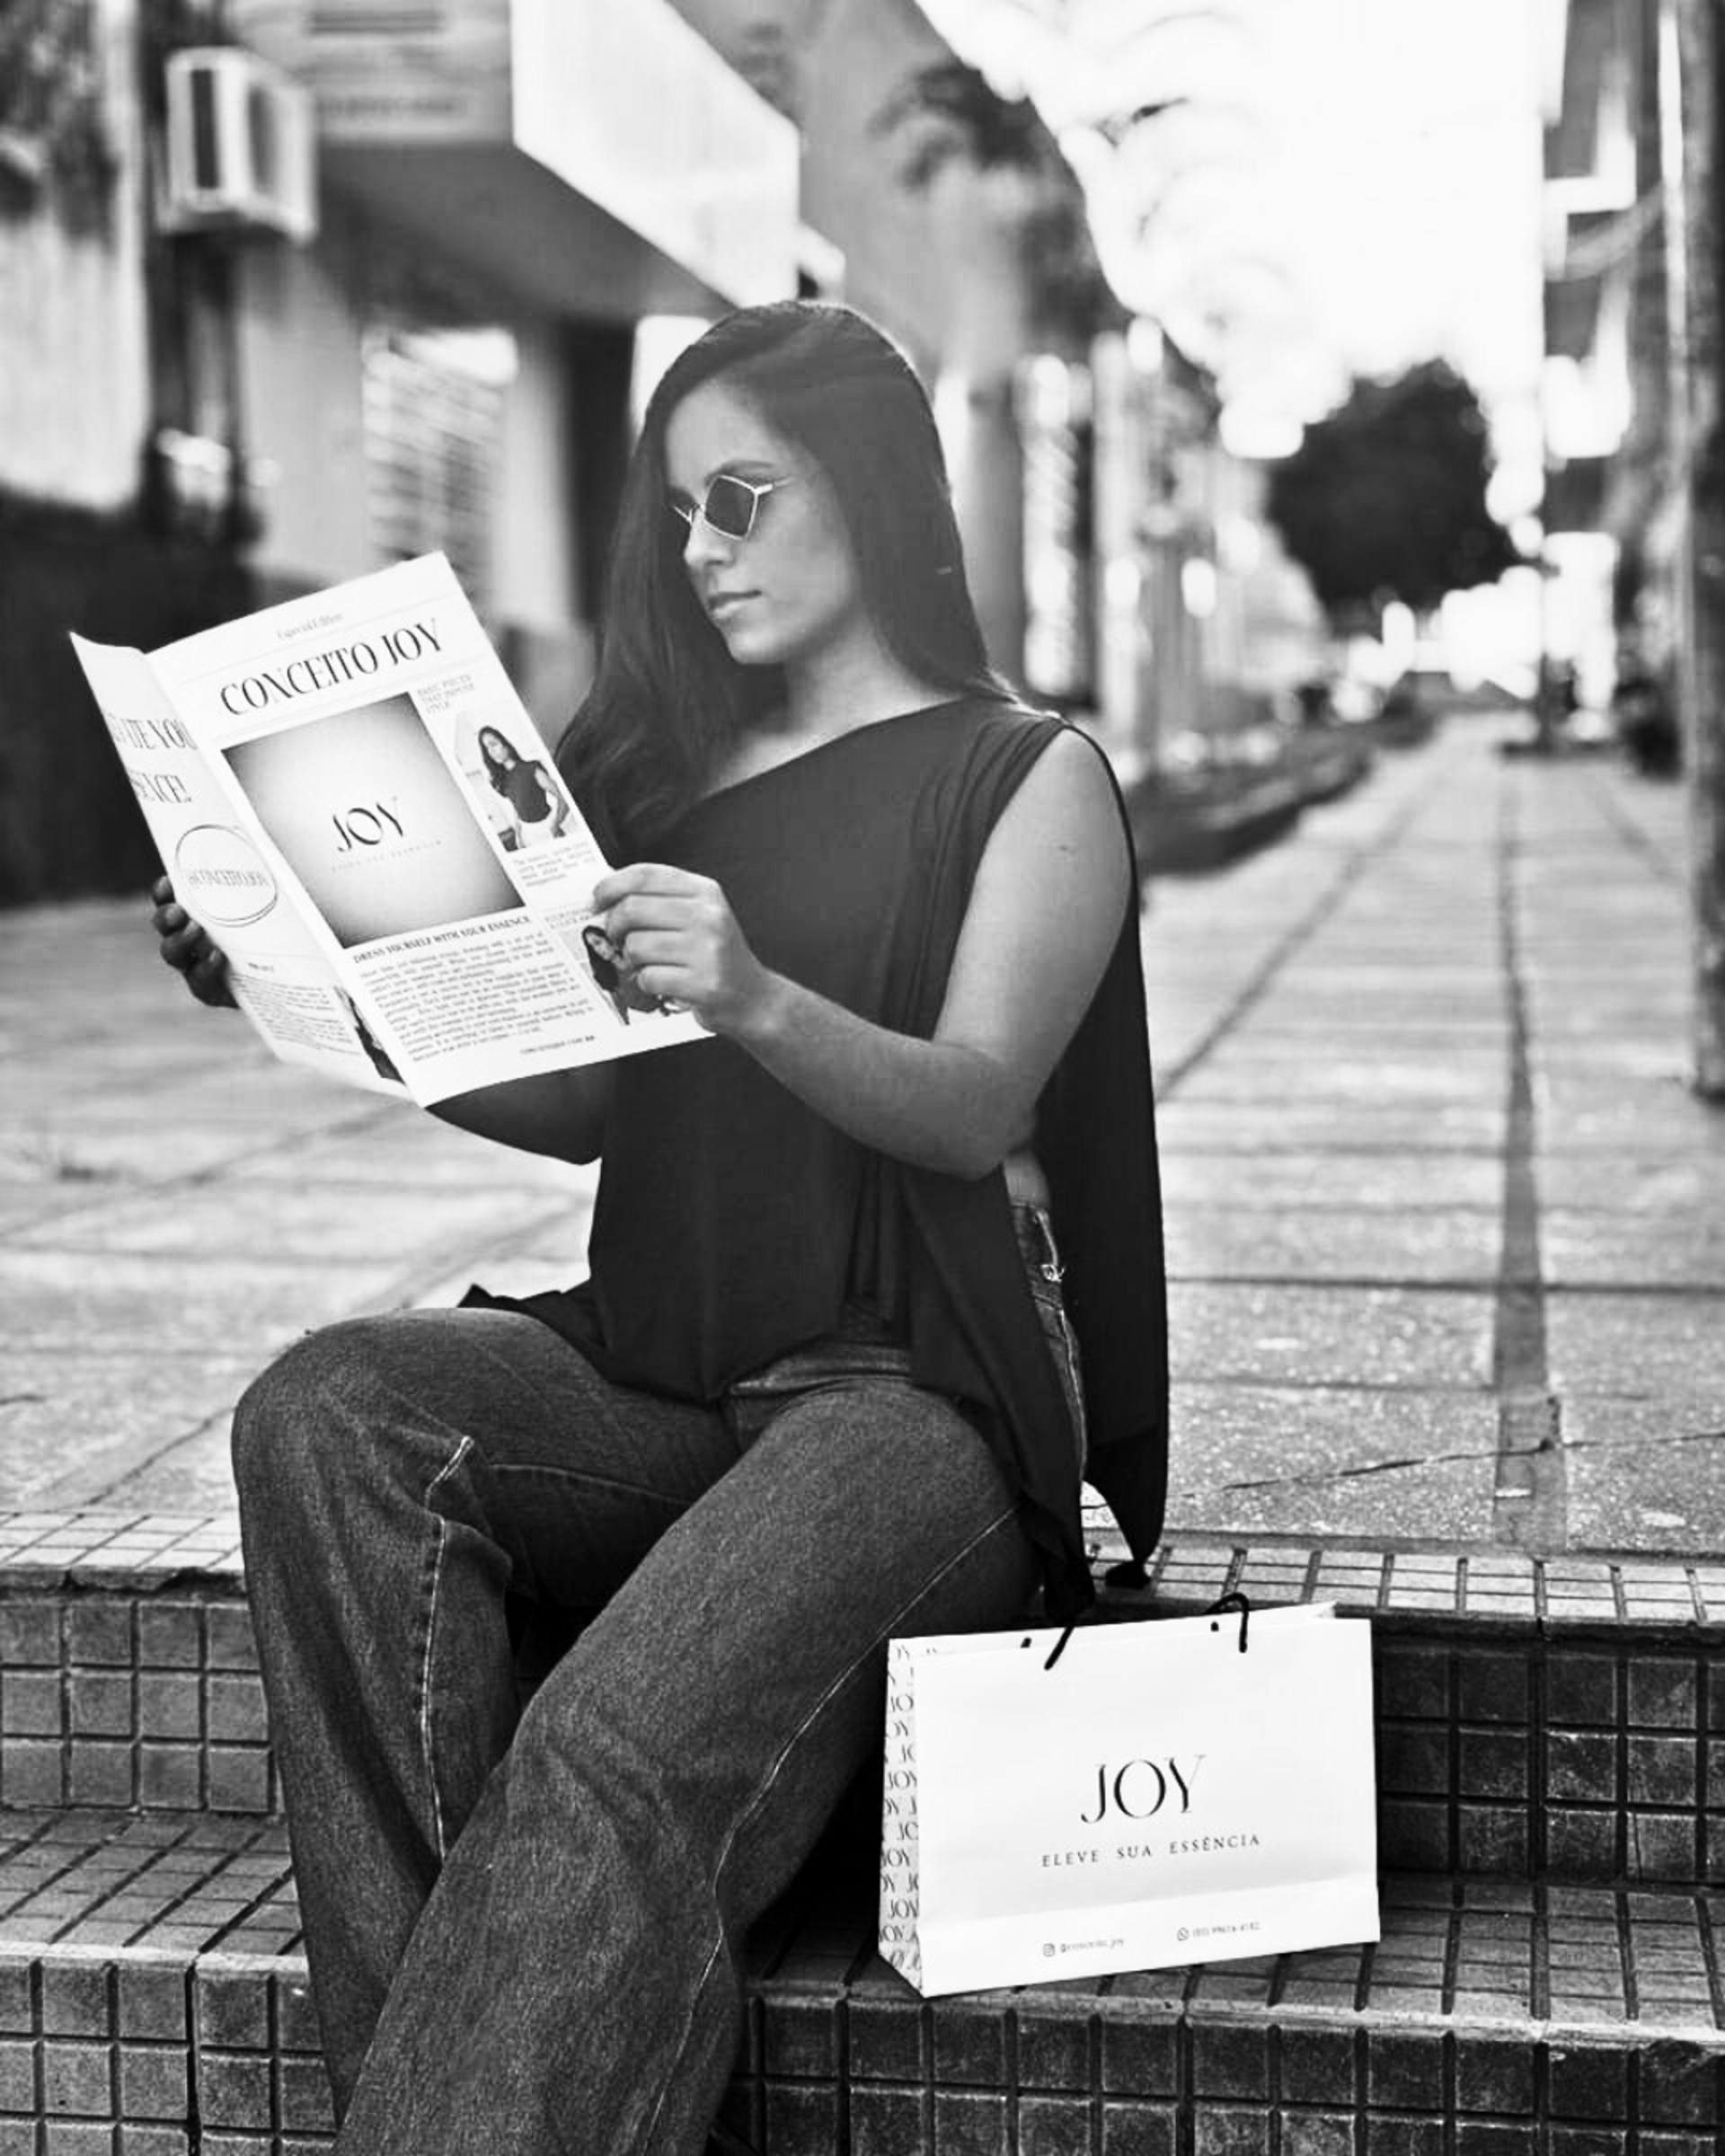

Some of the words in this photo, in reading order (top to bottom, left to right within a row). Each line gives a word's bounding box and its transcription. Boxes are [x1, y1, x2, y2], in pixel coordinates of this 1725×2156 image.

[220, 642, 378, 715] CONCEITO
[382, 618, 441, 666] JOY
[332, 796, 403, 852] JOY
[353, 949, 385, 964] DRESS
[386, 937, 432, 954] YOURSELF
[1081, 1754, 1206, 1824] JOY
[1042, 1850, 1100, 1868] ELEVE
[1117, 1845, 1153, 1860] SUA
[1169, 1834, 1260, 1854] ESSÊNCIA
